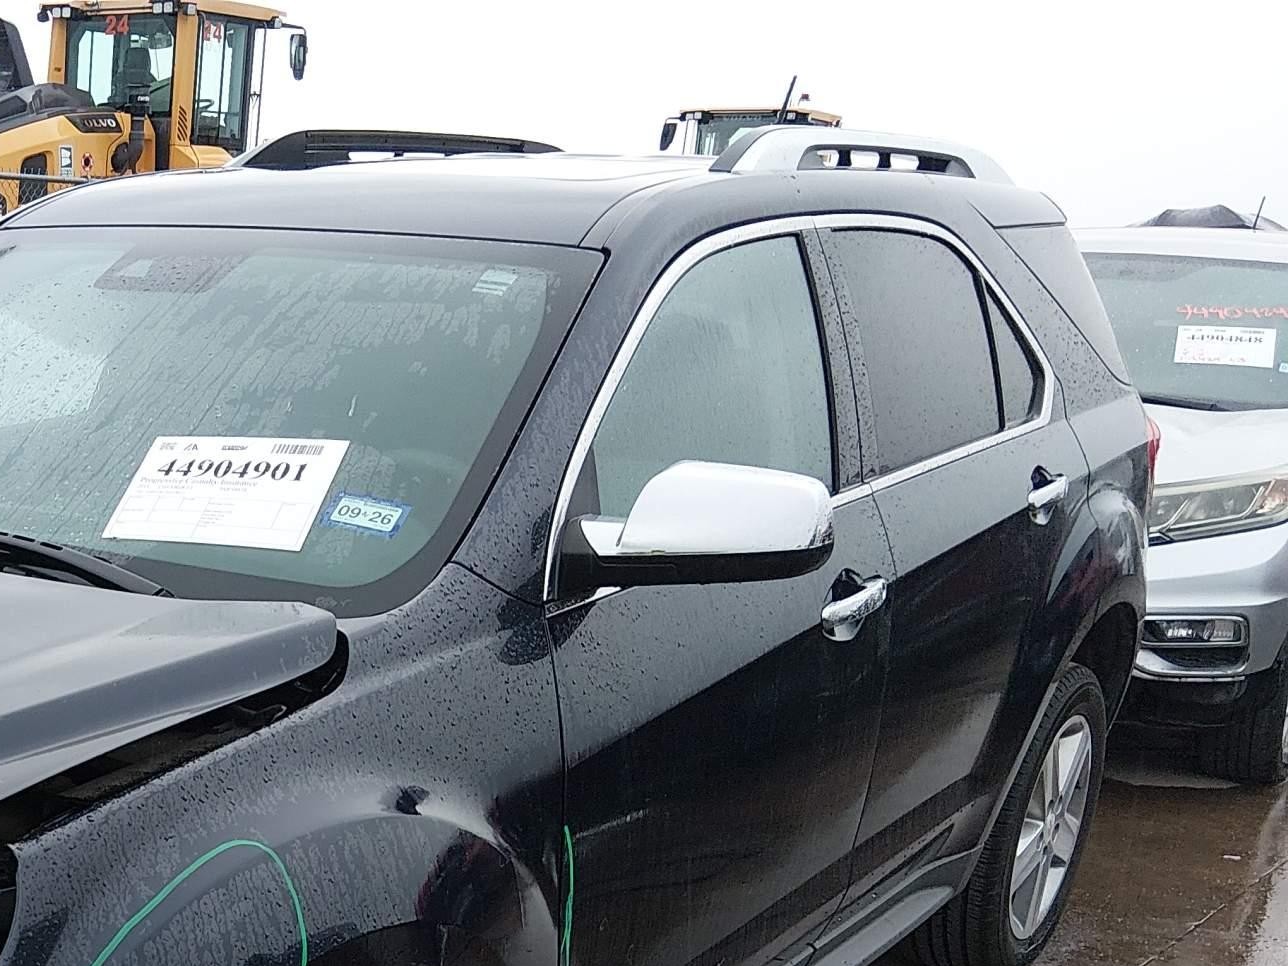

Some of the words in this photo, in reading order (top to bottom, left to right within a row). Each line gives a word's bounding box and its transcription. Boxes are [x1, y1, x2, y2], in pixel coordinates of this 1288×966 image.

[105, 15, 129, 35] 24
[82, 118, 116, 128] OLVO
[158, 458, 307, 481] 44904901
[338, 505, 361, 518] 09
[368, 511, 393, 525] 26
